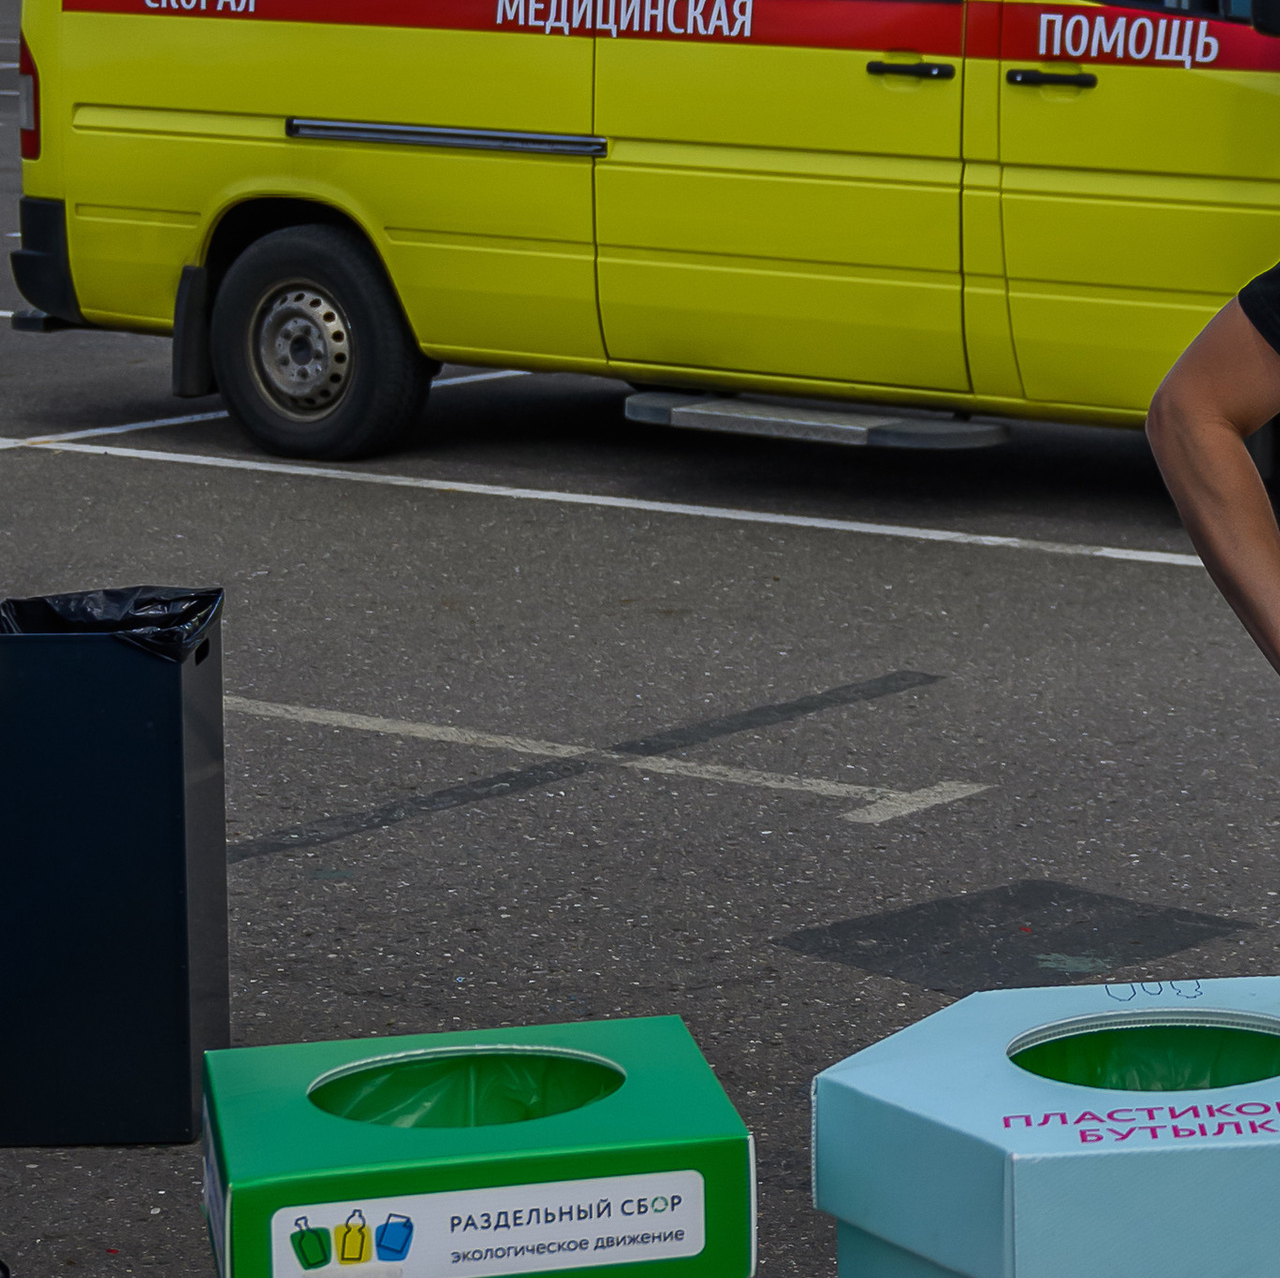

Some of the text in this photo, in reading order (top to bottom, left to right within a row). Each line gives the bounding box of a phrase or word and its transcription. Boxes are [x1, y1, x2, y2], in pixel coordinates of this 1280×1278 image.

[1038, 13, 1219, 70] ПОМОЩЬ
[450, 1195, 683, 1233] РАЗДЕЛЬНЫЙ СБОР
[450, 1229, 686, 1264] экологическое движение
